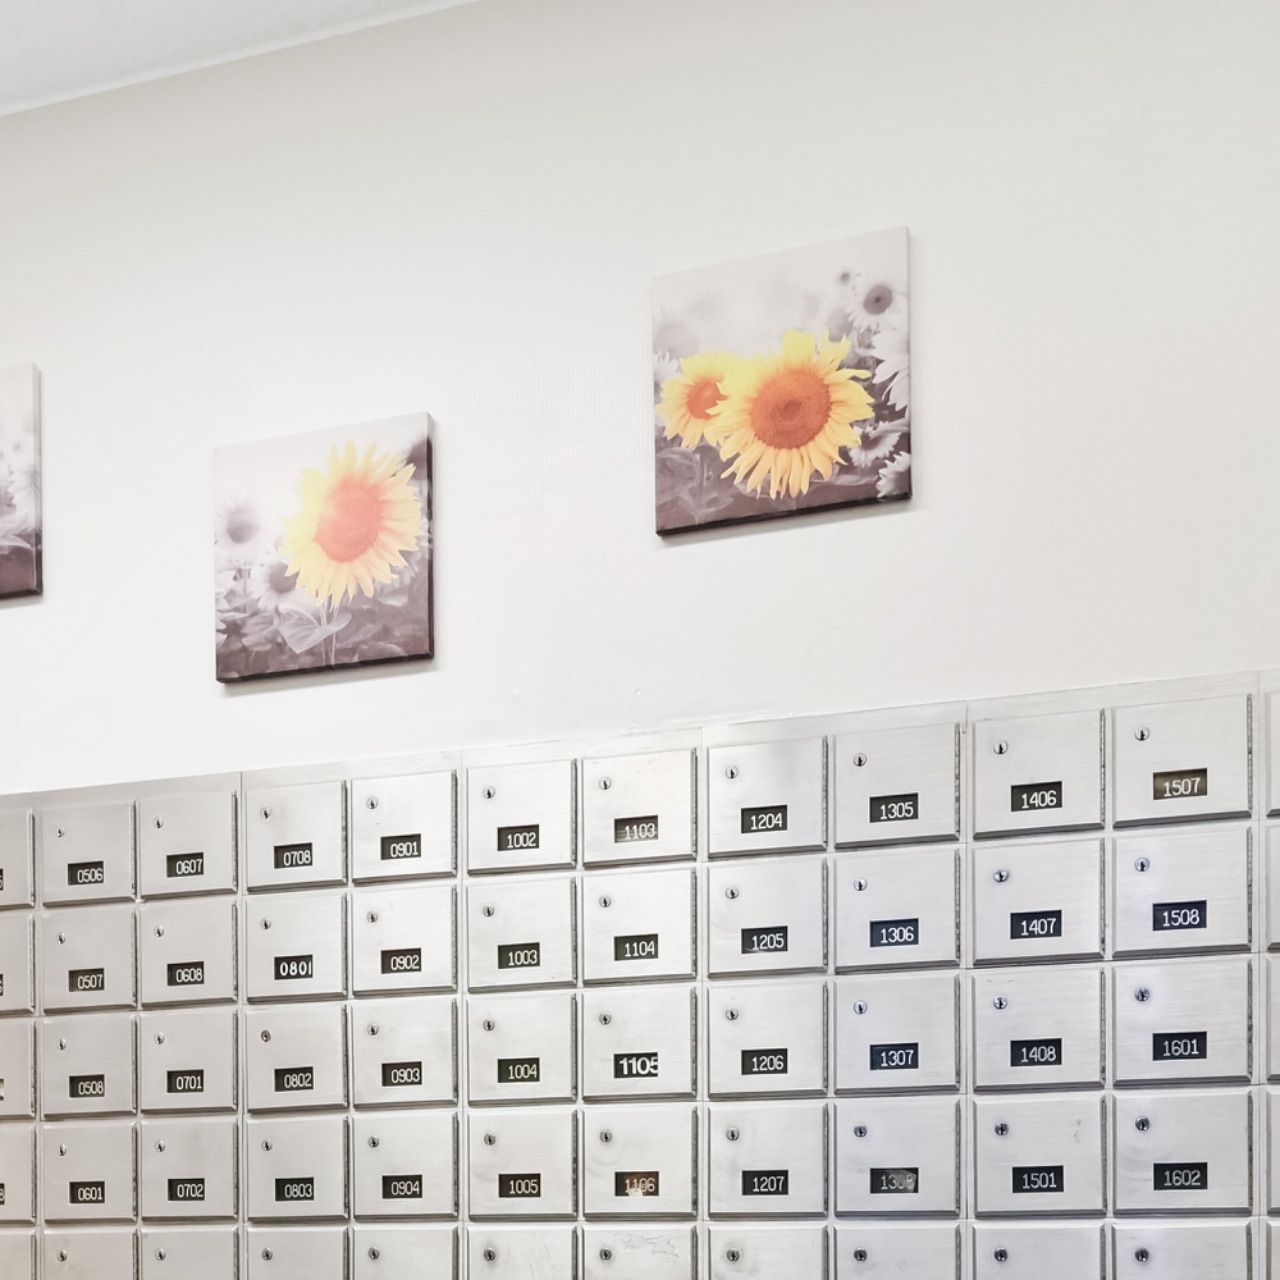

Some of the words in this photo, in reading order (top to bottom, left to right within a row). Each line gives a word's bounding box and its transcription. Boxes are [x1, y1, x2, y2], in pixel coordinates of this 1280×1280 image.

[1164, 777, 1200, 795] 1507
[1022, 790, 1056, 807] 1406
[881, 802, 913, 818] 1305
[751, 813, 782, 829] 1204
[625, 823, 656, 838] 1103
[508, 832, 536, 847] 1002
[390, 842, 418, 856] 0901
[284, 850, 311, 864] 0708
[176, 859, 202, 873] 0607
[78, 868, 103, 881] 0506
[1163, 909, 1199, 926] 1508
[1021, 918, 1056, 935] 1407
[753, 933, 784, 949] 1205
[881, 926, 914, 943] 1306
[625, 941, 654, 957] 1104
[391, 955, 419, 970] 0902
[509, 950, 537, 965] 1003
[176, 968, 202, 982] 0608
[280, 962, 311, 976] 0801
[78, 974, 103, 988] 0507
[1022, 1046, 1056, 1063] 1408
[1164, 1039, 1199, 1056] 1601
[753, 1055, 783, 1071] 1206
[882, 1050, 914, 1066] 1307
[509, 1064, 537, 1079] 1004
[620, 1057, 657, 1075] 1105
[177, 1076, 201, 1090] 0701
[284, 1073, 311, 1088] 0802
[392, 1068, 420, 1083] 0903
[78, 1081, 104, 1094] 0508
[753, 1176, 784, 1192] 1207
[1023, 1173, 1056, 1189] 1501
[1164, 1170, 1201, 1186] 1602
[78, 1187, 102, 1201] 0601
[177, 1184, 203, 1198] 0702
[285, 1184, 312, 1198] 0803
[392, 1181, 419, 1195] 0904
[510, 1180, 538, 1195] 1005
